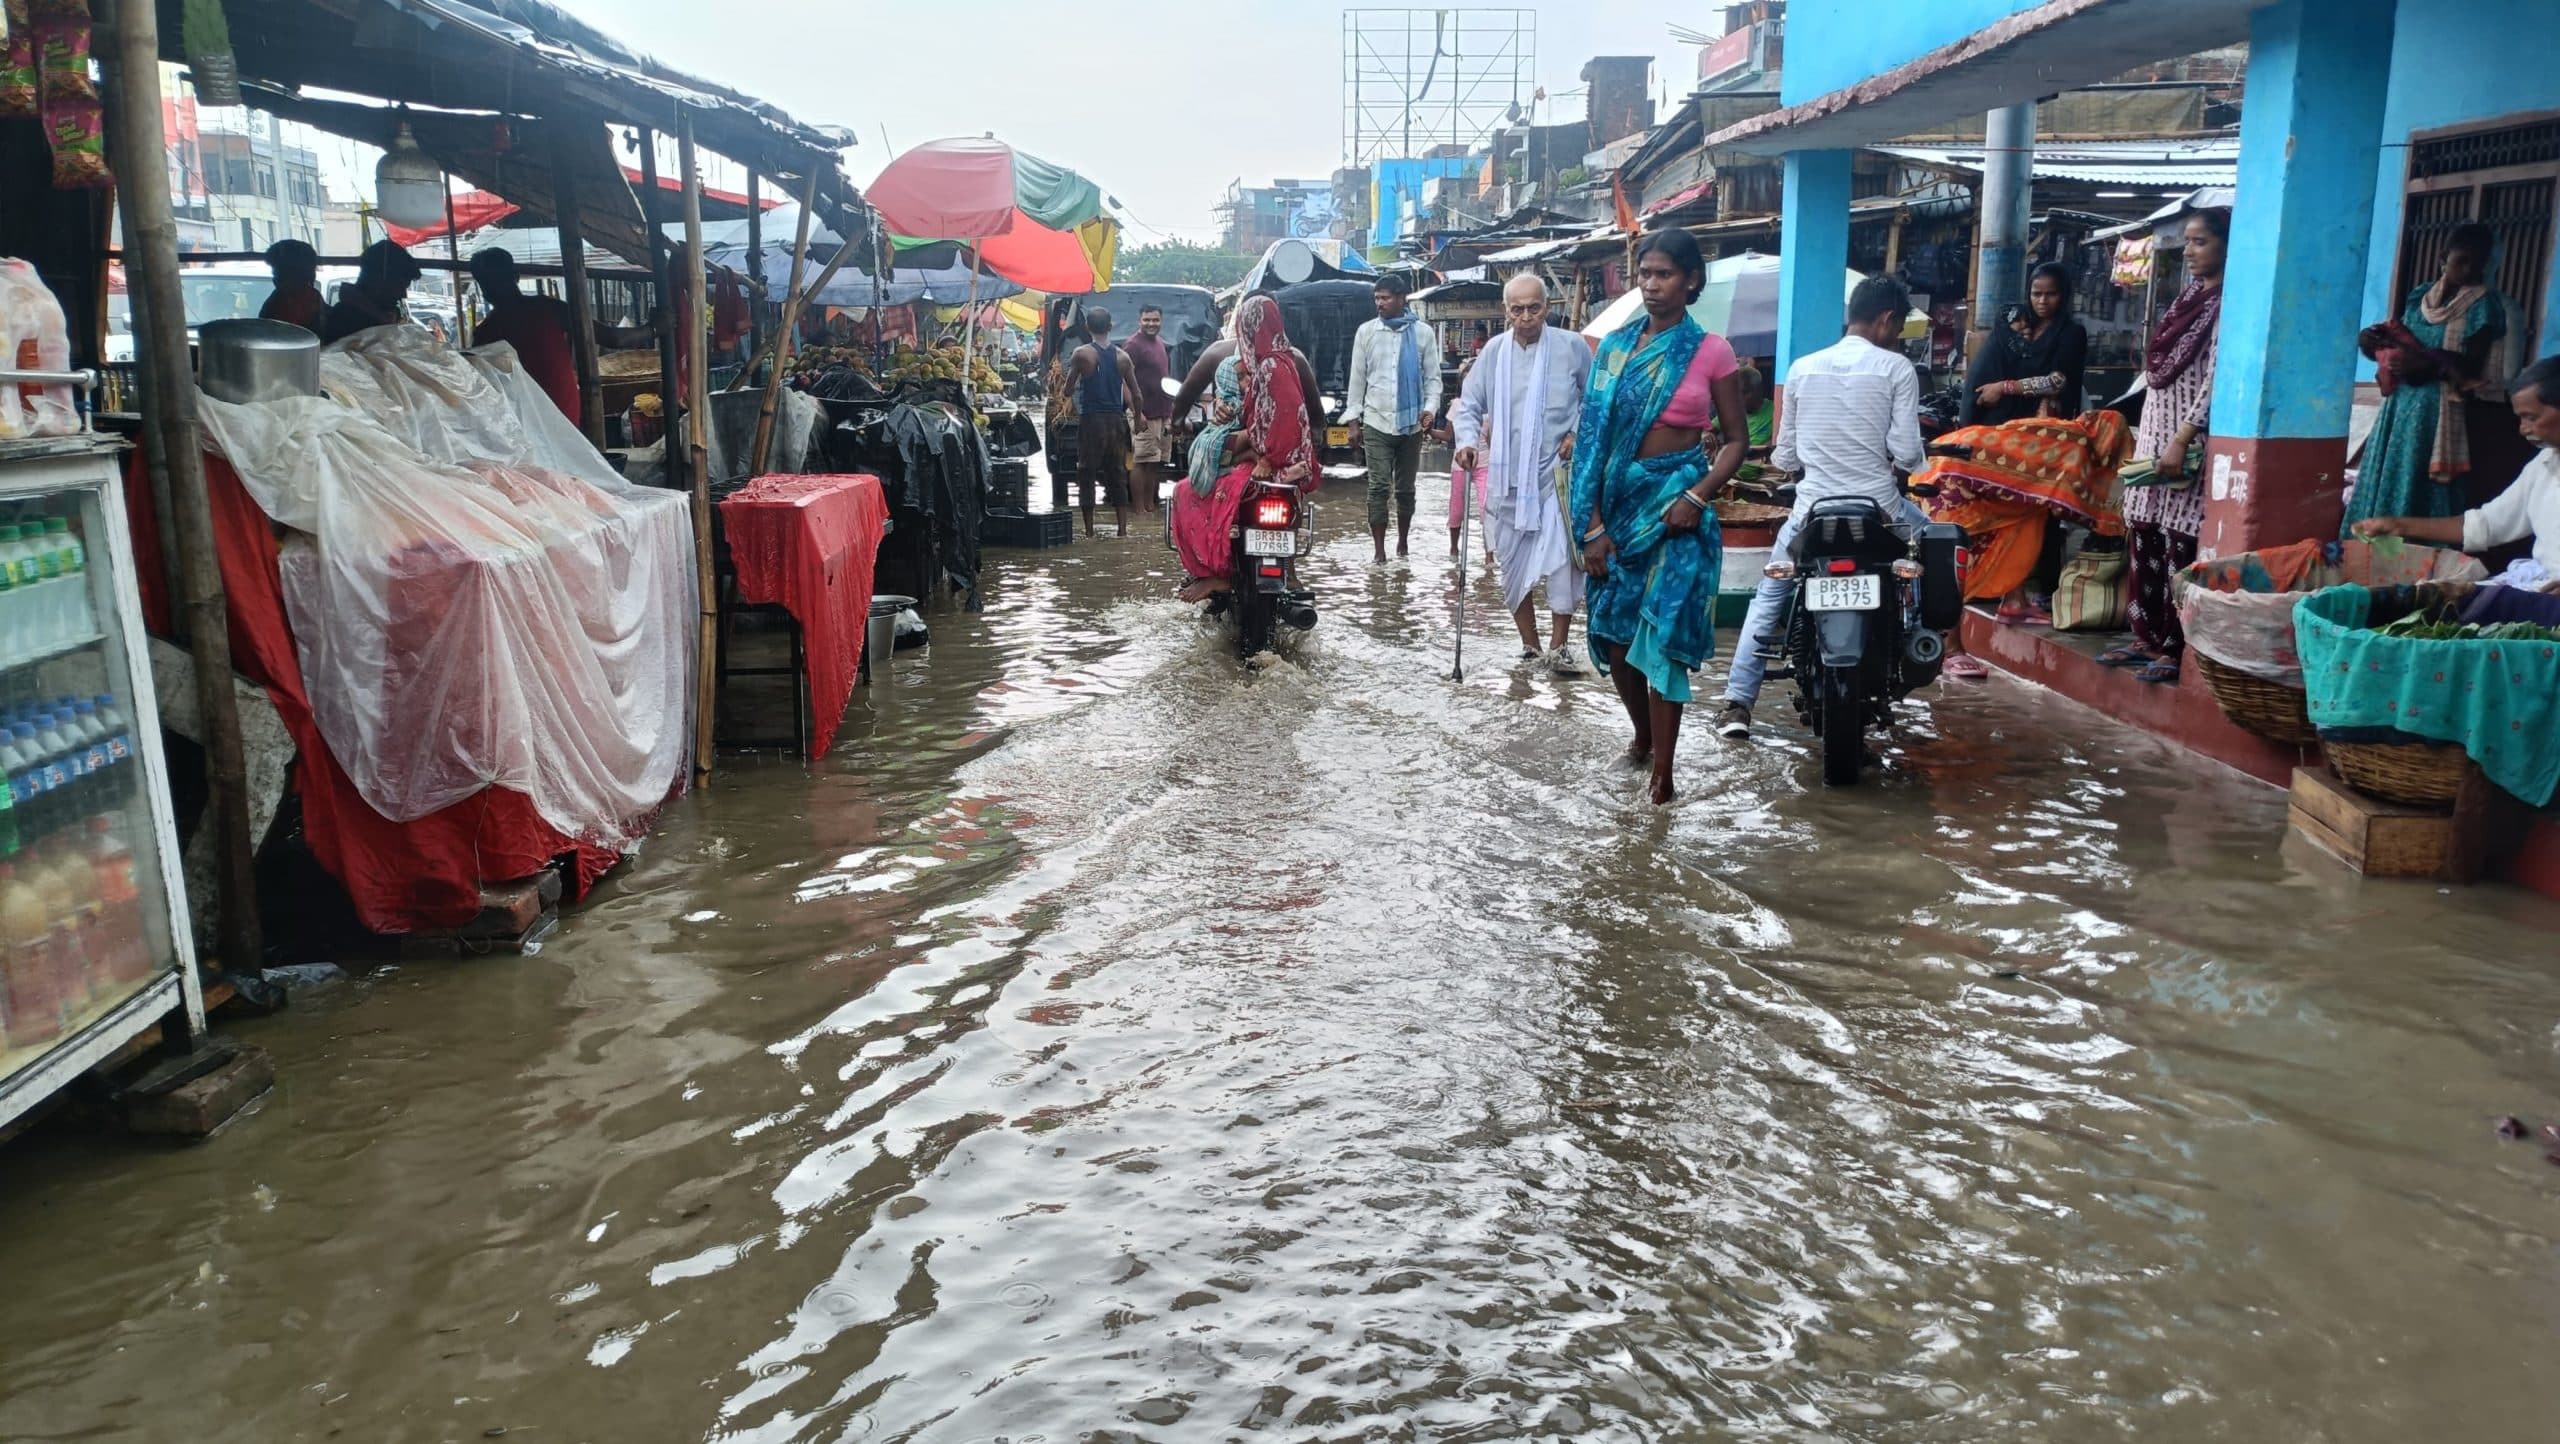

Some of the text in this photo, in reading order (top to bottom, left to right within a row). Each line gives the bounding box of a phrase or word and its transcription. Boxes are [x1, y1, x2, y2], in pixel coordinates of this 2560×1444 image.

[1255, 531, 1289, 542] BR39A
[1819, 578, 1870, 593] BR39A
[1820, 592, 1871, 607] L2175
